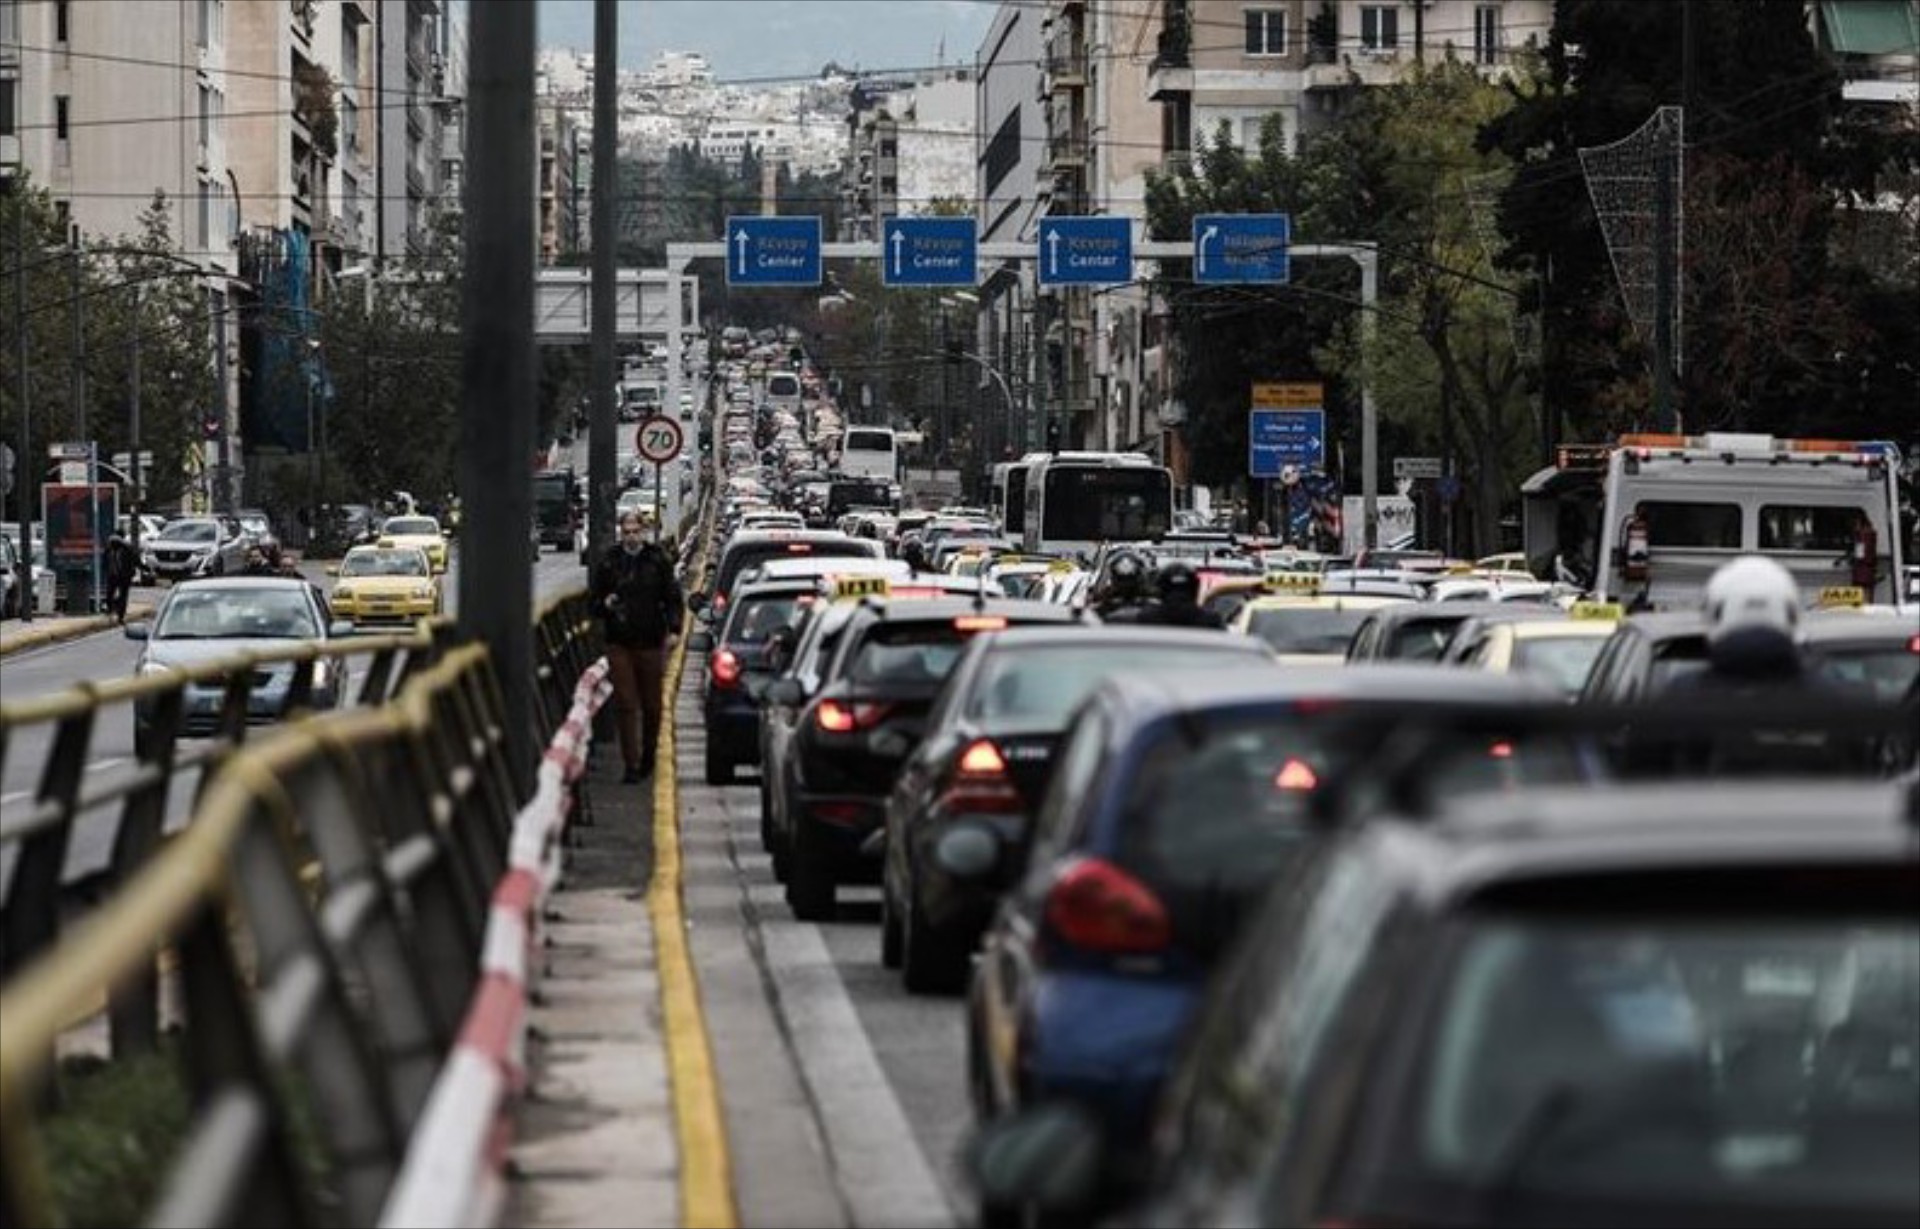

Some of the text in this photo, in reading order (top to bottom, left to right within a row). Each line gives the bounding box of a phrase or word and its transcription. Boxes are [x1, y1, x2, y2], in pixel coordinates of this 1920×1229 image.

[758, 253, 805, 268] Center
[913, 253, 961, 268] Center
[1069, 253, 1117, 268] Center
[647, 431, 674, 449] 70
